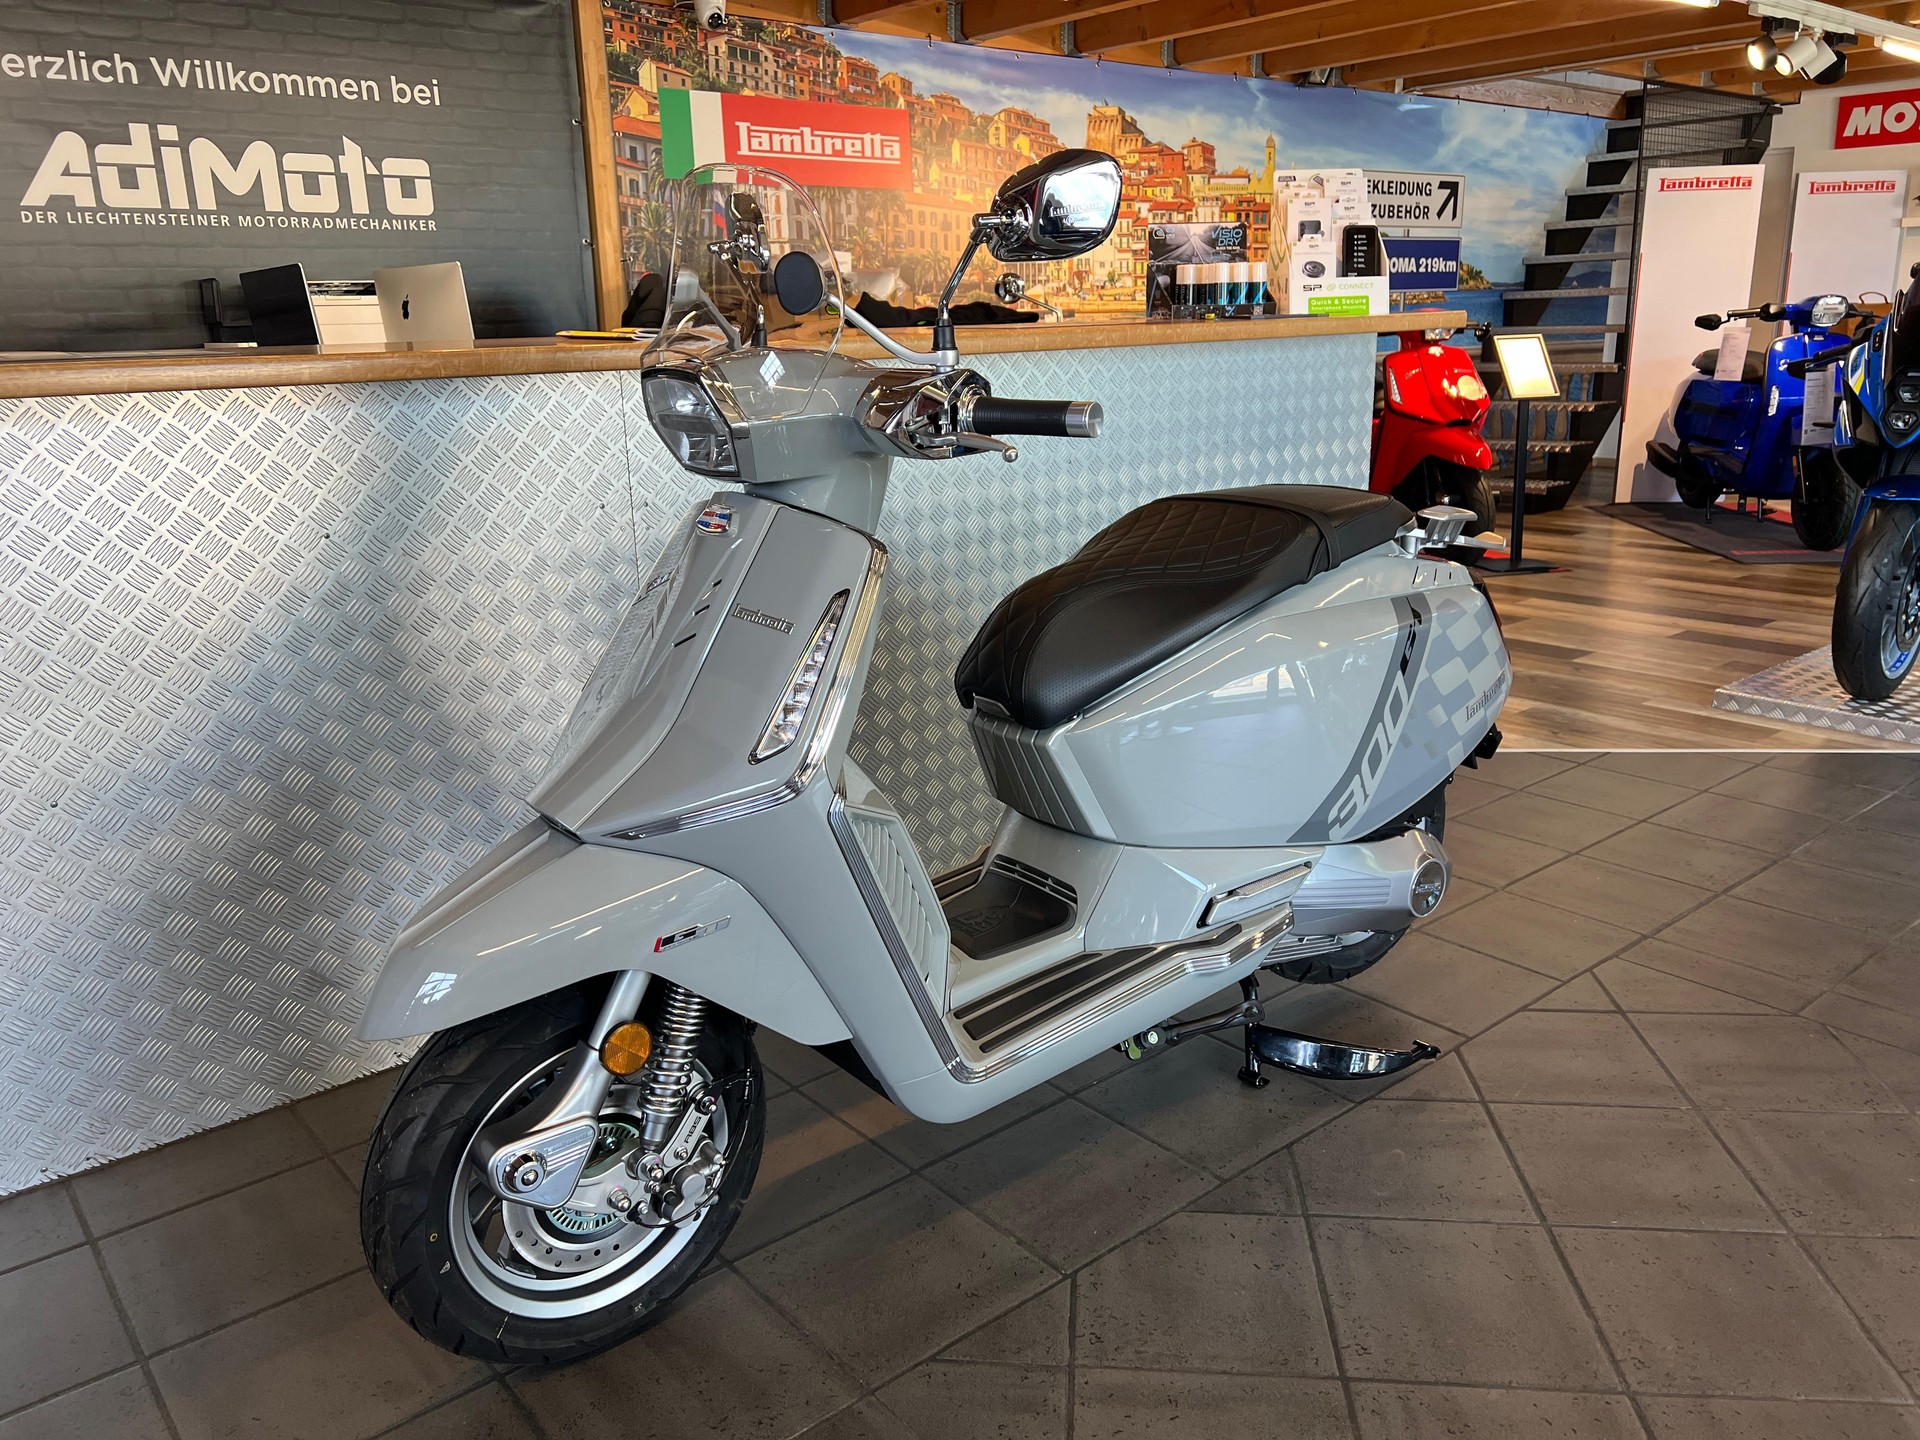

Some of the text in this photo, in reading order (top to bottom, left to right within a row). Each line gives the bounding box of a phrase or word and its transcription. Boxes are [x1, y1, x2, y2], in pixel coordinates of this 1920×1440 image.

[149, 56, 380, 101] Willkommen
[390, 75, 441, 106] bei
[1842, 100, 1920, 137] MO
[735, 121, 901, 164] Lambretta
[20, 122, 435, 216] AdiMoto
[1658, 176, 1753, 193] Lambretta
[1808, 180, 1897, 195] Lambretta
[1371, 201, 1430, 220] ZUBEHÖR
[20, 210, 437, 232] DER LIECHTENSTEINER MOTORRADMECHANIKER
[1211, 226, 1243, 239] VISIO
[1217, 238, 1242, 247] DRY
[1418, 257, 1457, 273] 219km
[1338, 282, 1374, 290] CONNECT
[1327, 670, 1410, 842] 300
